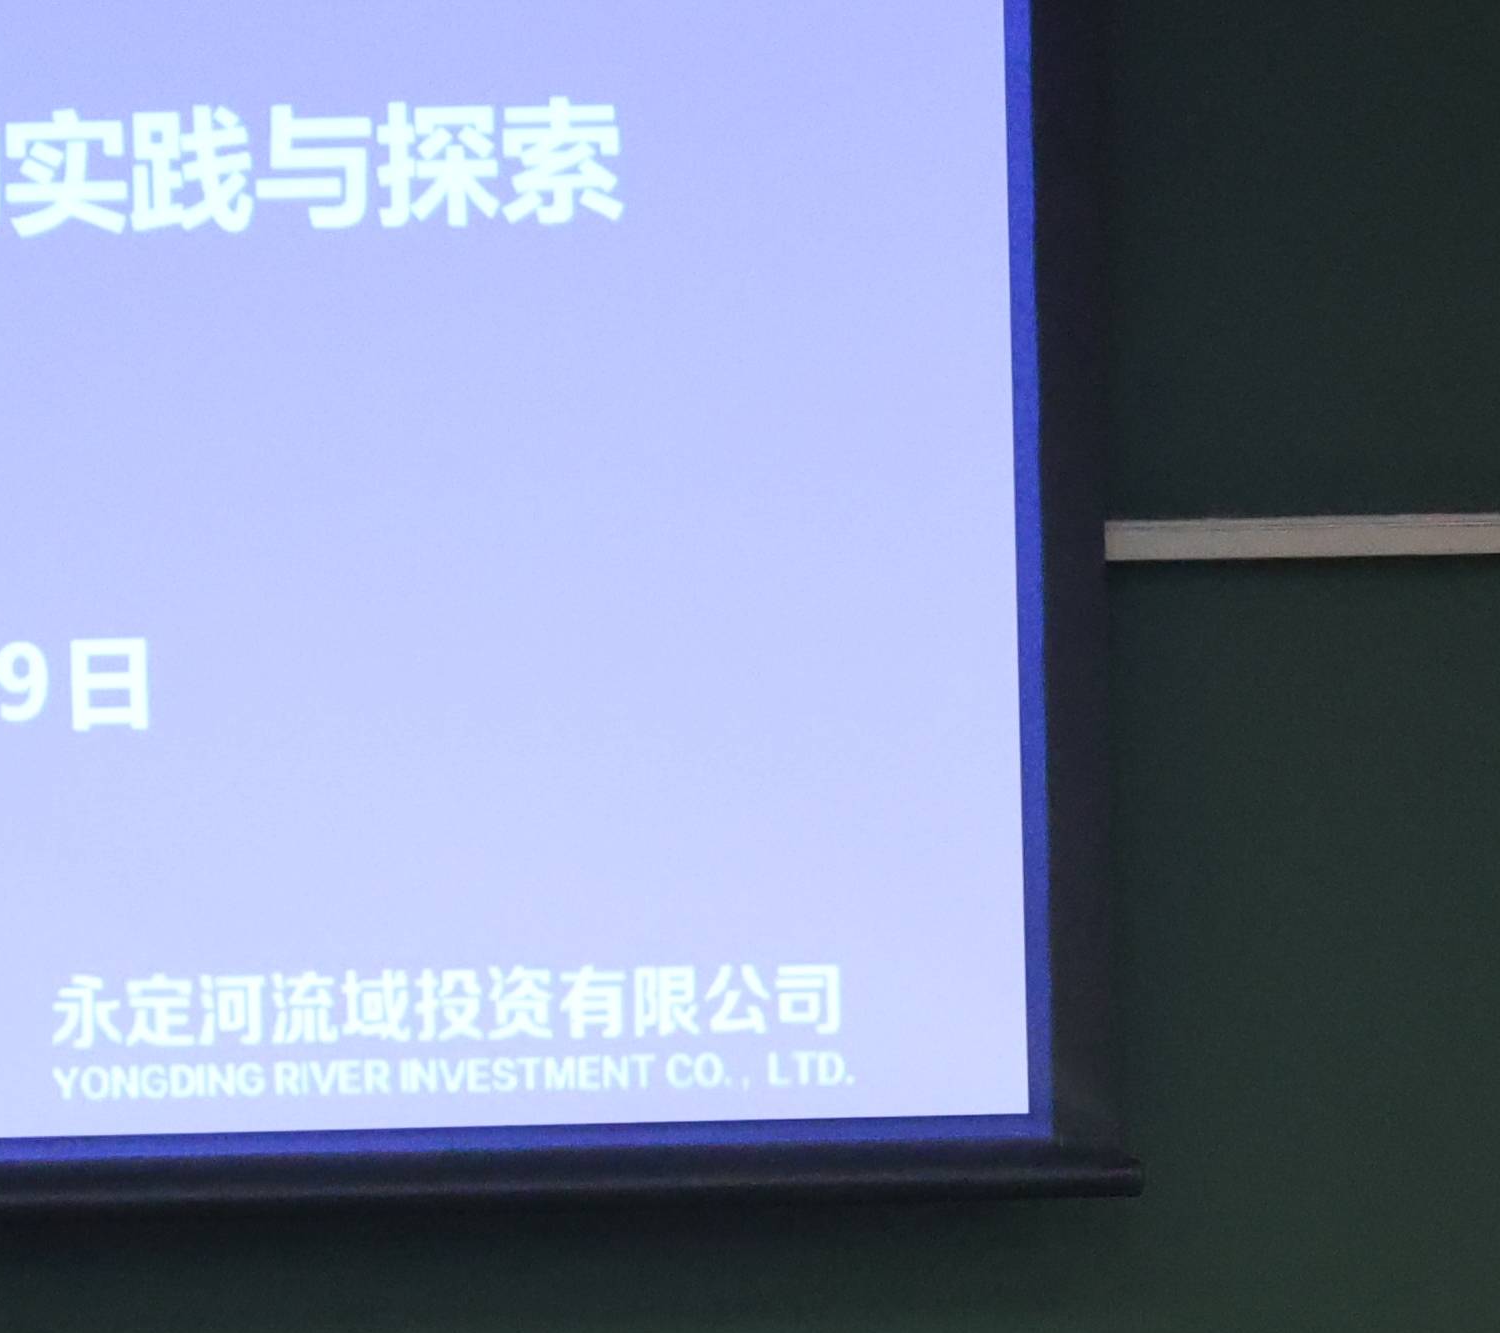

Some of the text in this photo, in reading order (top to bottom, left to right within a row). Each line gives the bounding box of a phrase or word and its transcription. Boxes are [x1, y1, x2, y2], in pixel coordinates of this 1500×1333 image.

[52, 963, 843, 1050] 永定河流域投资有限公司
[52, 1062, 266, 1100] YONGDING
[274, 1059, 390, 1095] RIVER
[400, 1055, 656, 1092] INVESTMENT
[768, 1052, 856, 1087] LTD.
